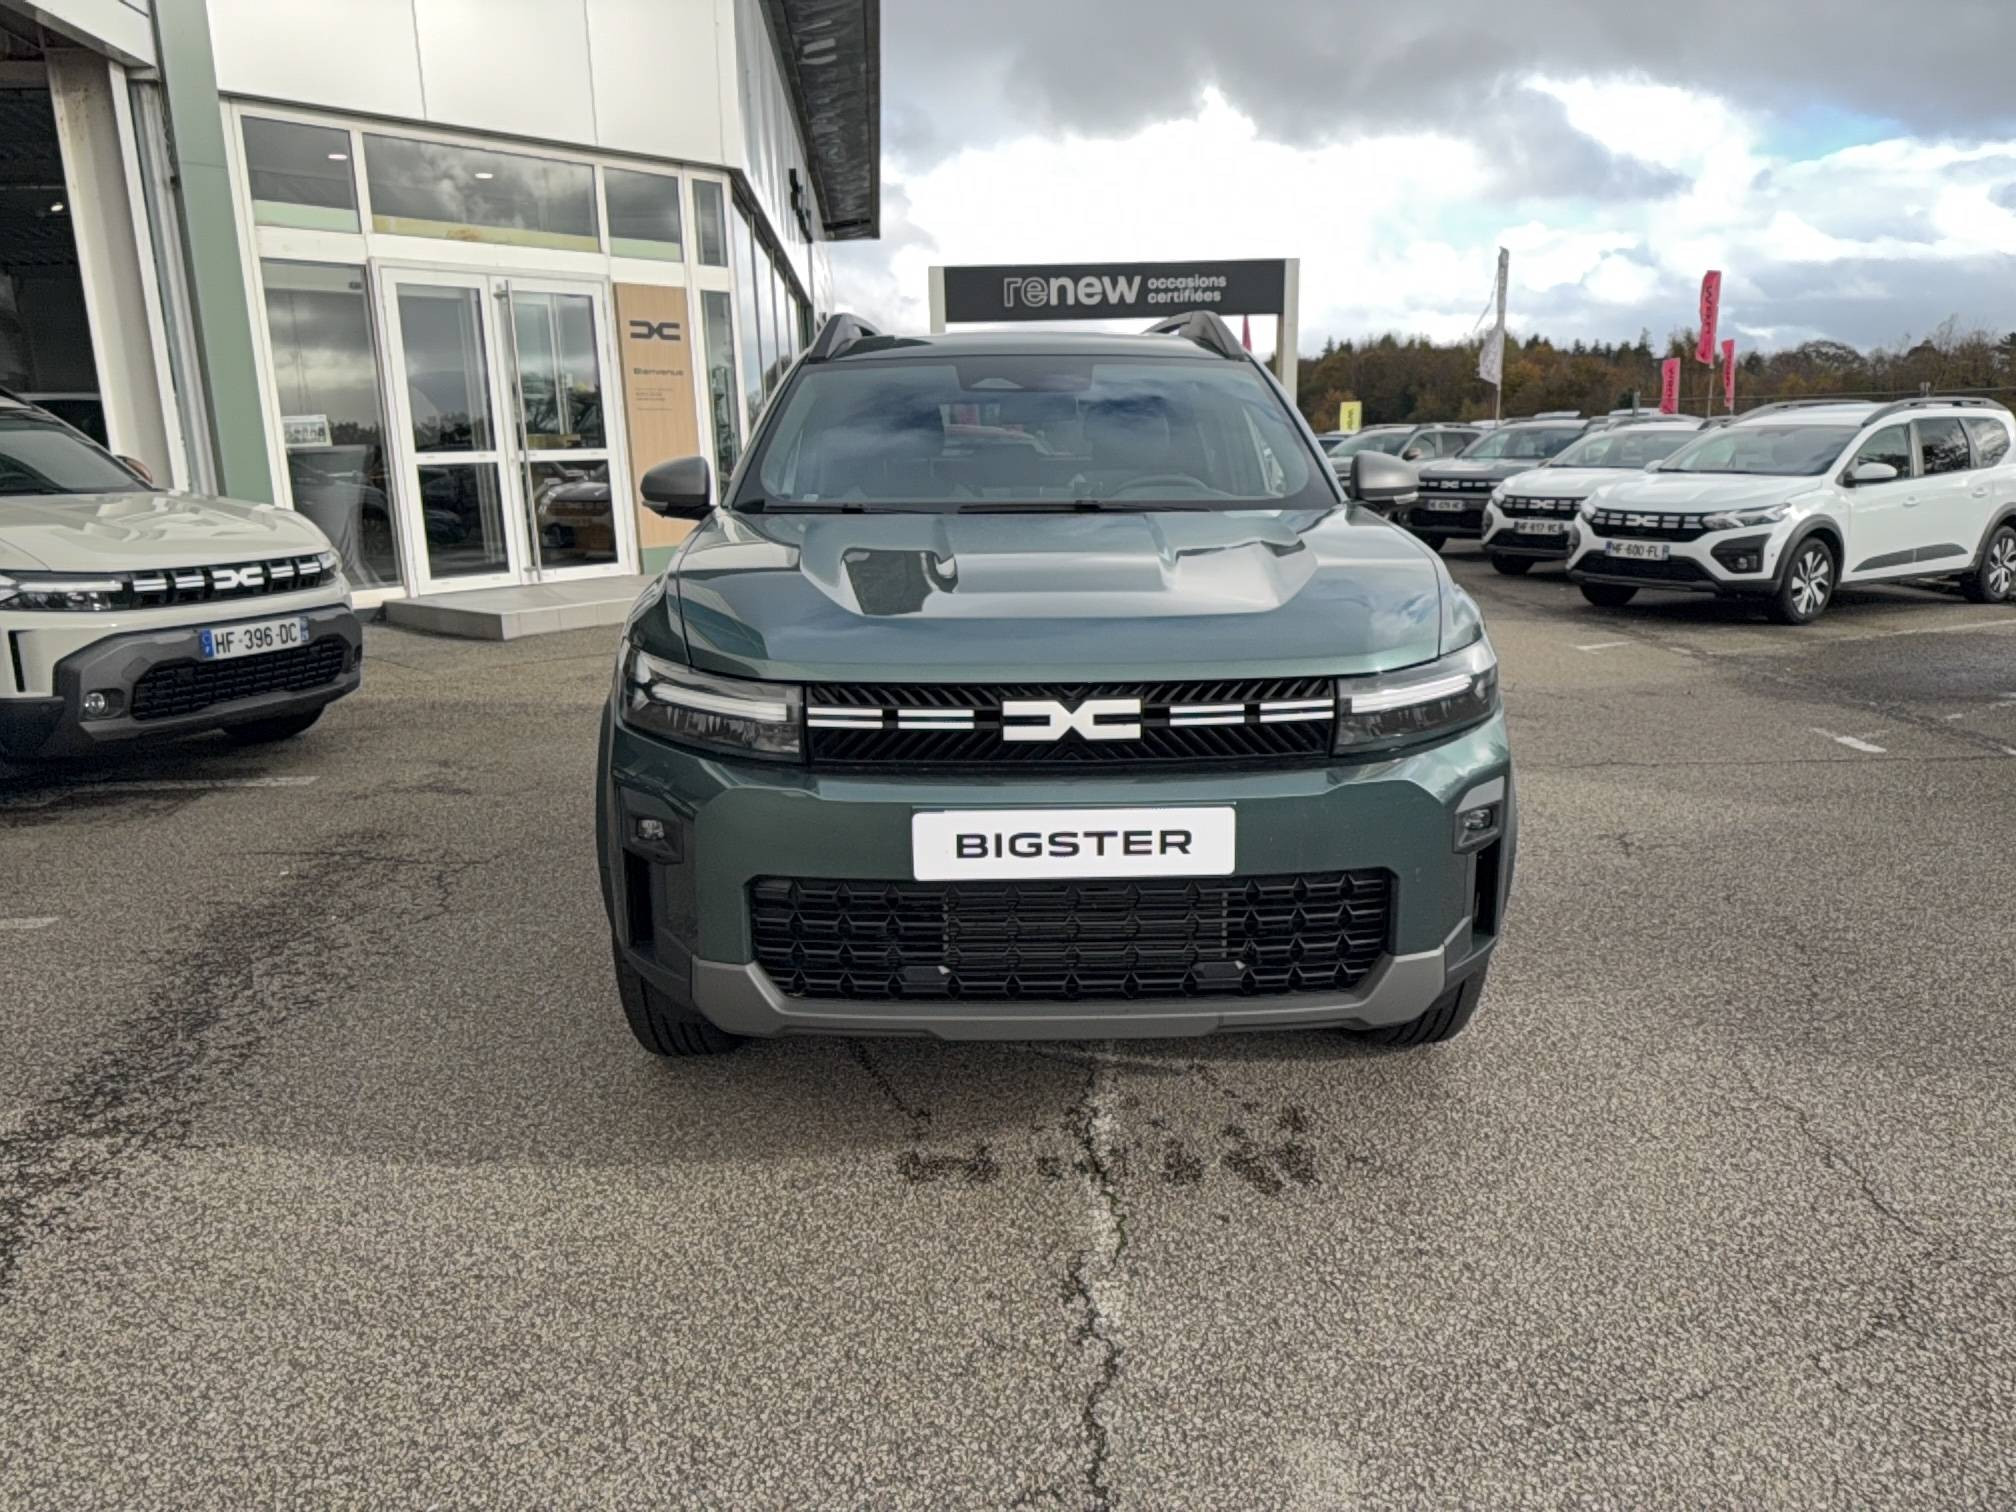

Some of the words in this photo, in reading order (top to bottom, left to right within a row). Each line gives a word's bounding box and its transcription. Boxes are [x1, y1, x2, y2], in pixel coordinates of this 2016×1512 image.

[1003, 275, 1142, 307] renew
[1147, 274, 1228, 289] occasions
[1147, 287, 1223, 304] certifiées
[955, 829, 1193, 859] BIGSTER
